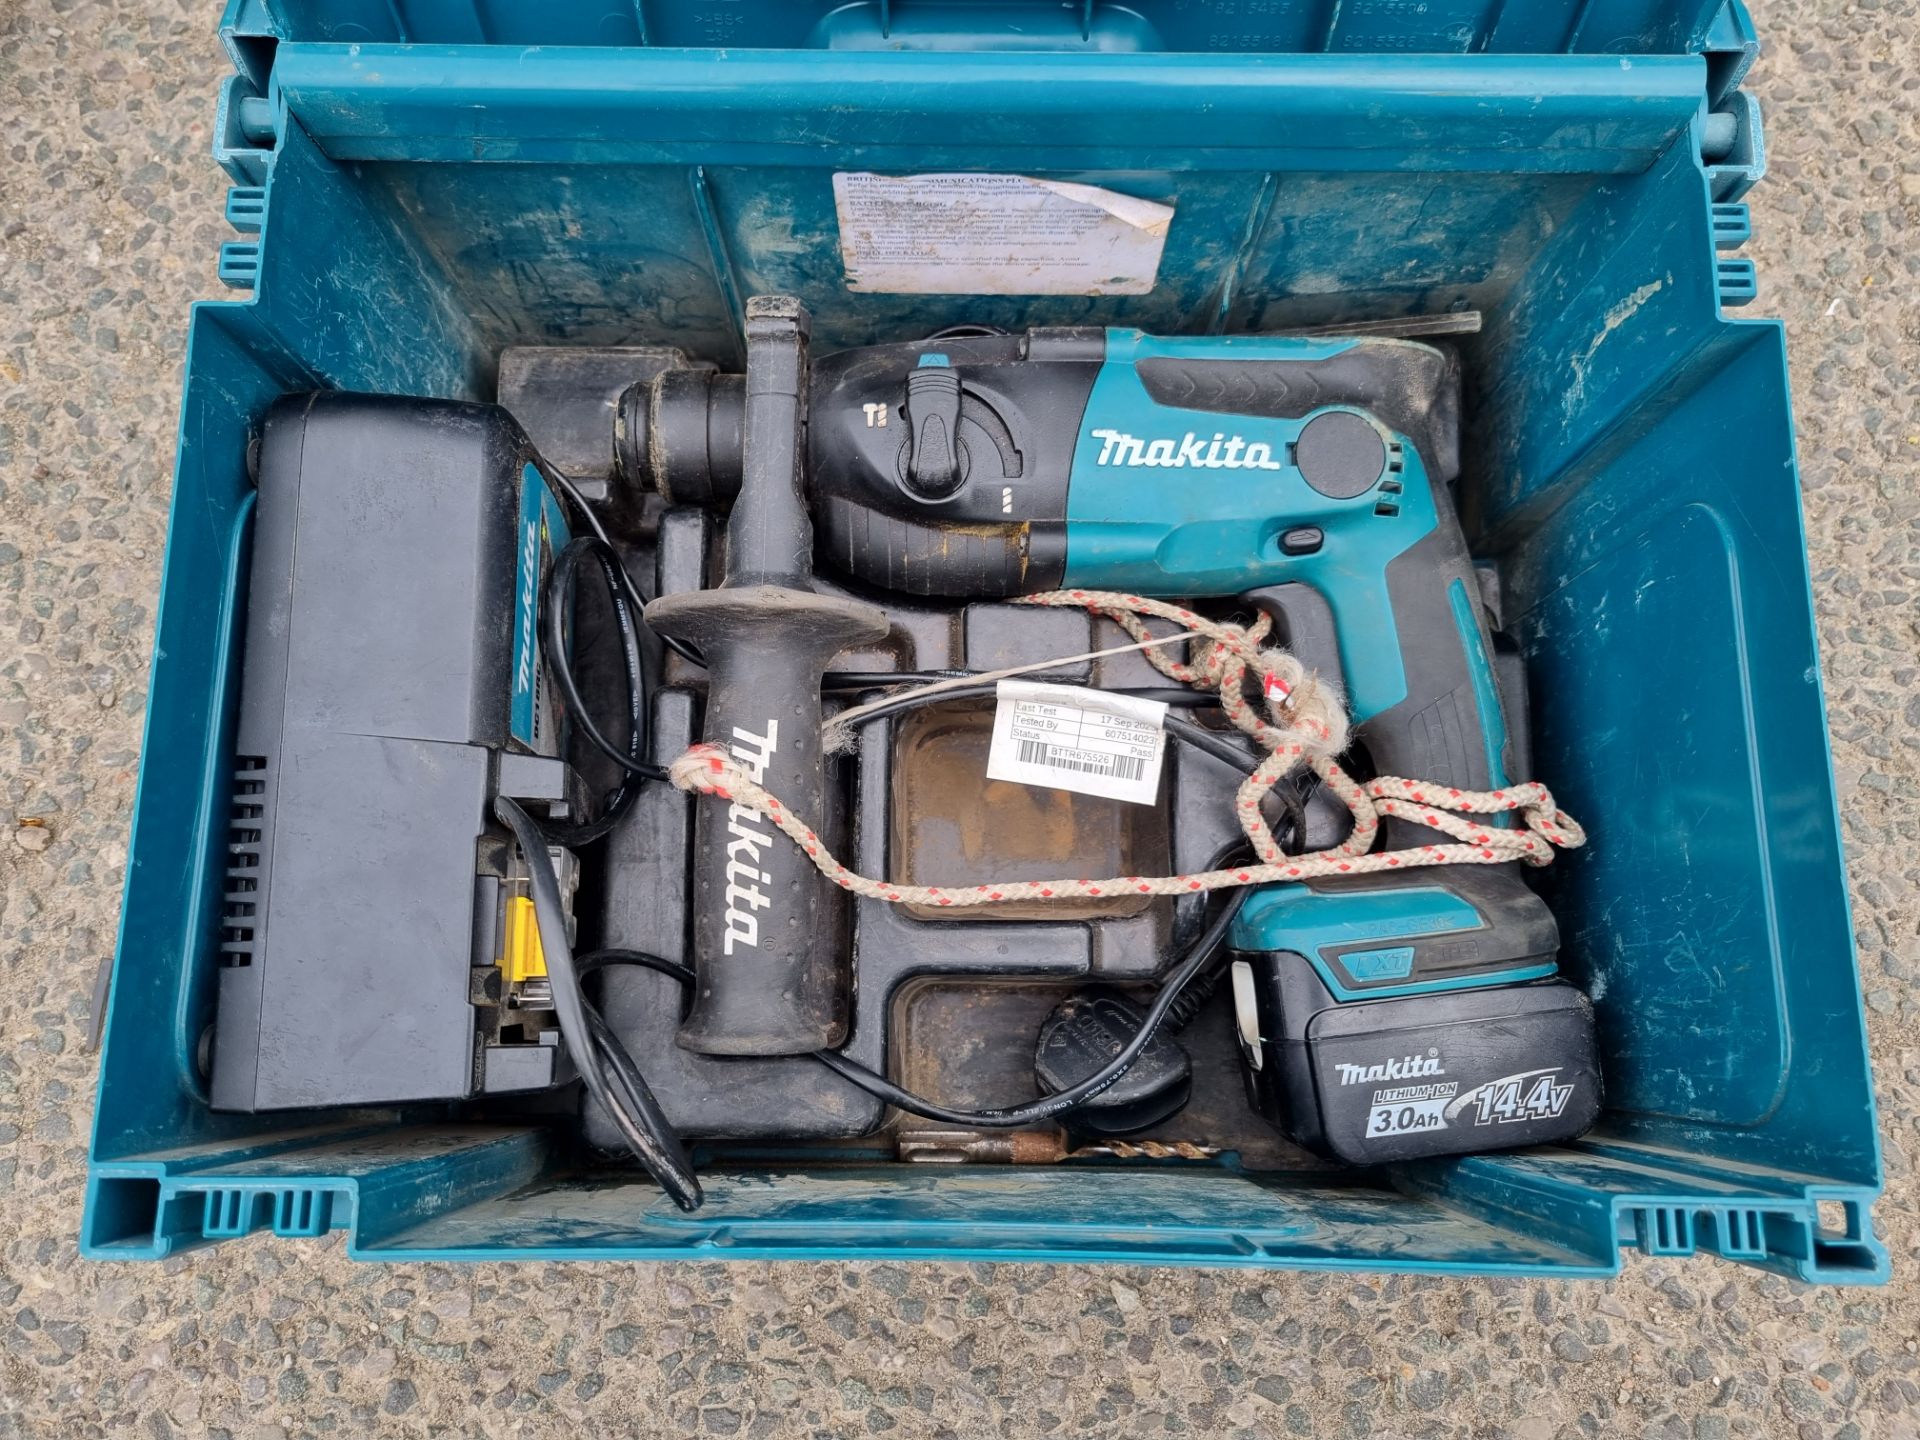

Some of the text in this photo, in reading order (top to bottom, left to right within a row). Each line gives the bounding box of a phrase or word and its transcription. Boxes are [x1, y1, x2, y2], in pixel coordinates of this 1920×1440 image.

[1016, 701, 1057, 716] Last Test
[1015, 715, 1059, 732] Tested By
[1101, 715, 1157, 732] 17 Sep 202
[1012, 727, 1041, 741] Status
[1105, 728, 1155, 745] 607514023
[1050, 746, 1110, 764] BTTR675526
[1130, 746, 1153, 758] Pass
[1373, 1082, 1458, 1105] LITHIUM-ION
[1373, 1106, 1439, 1134] 3.0Ah
